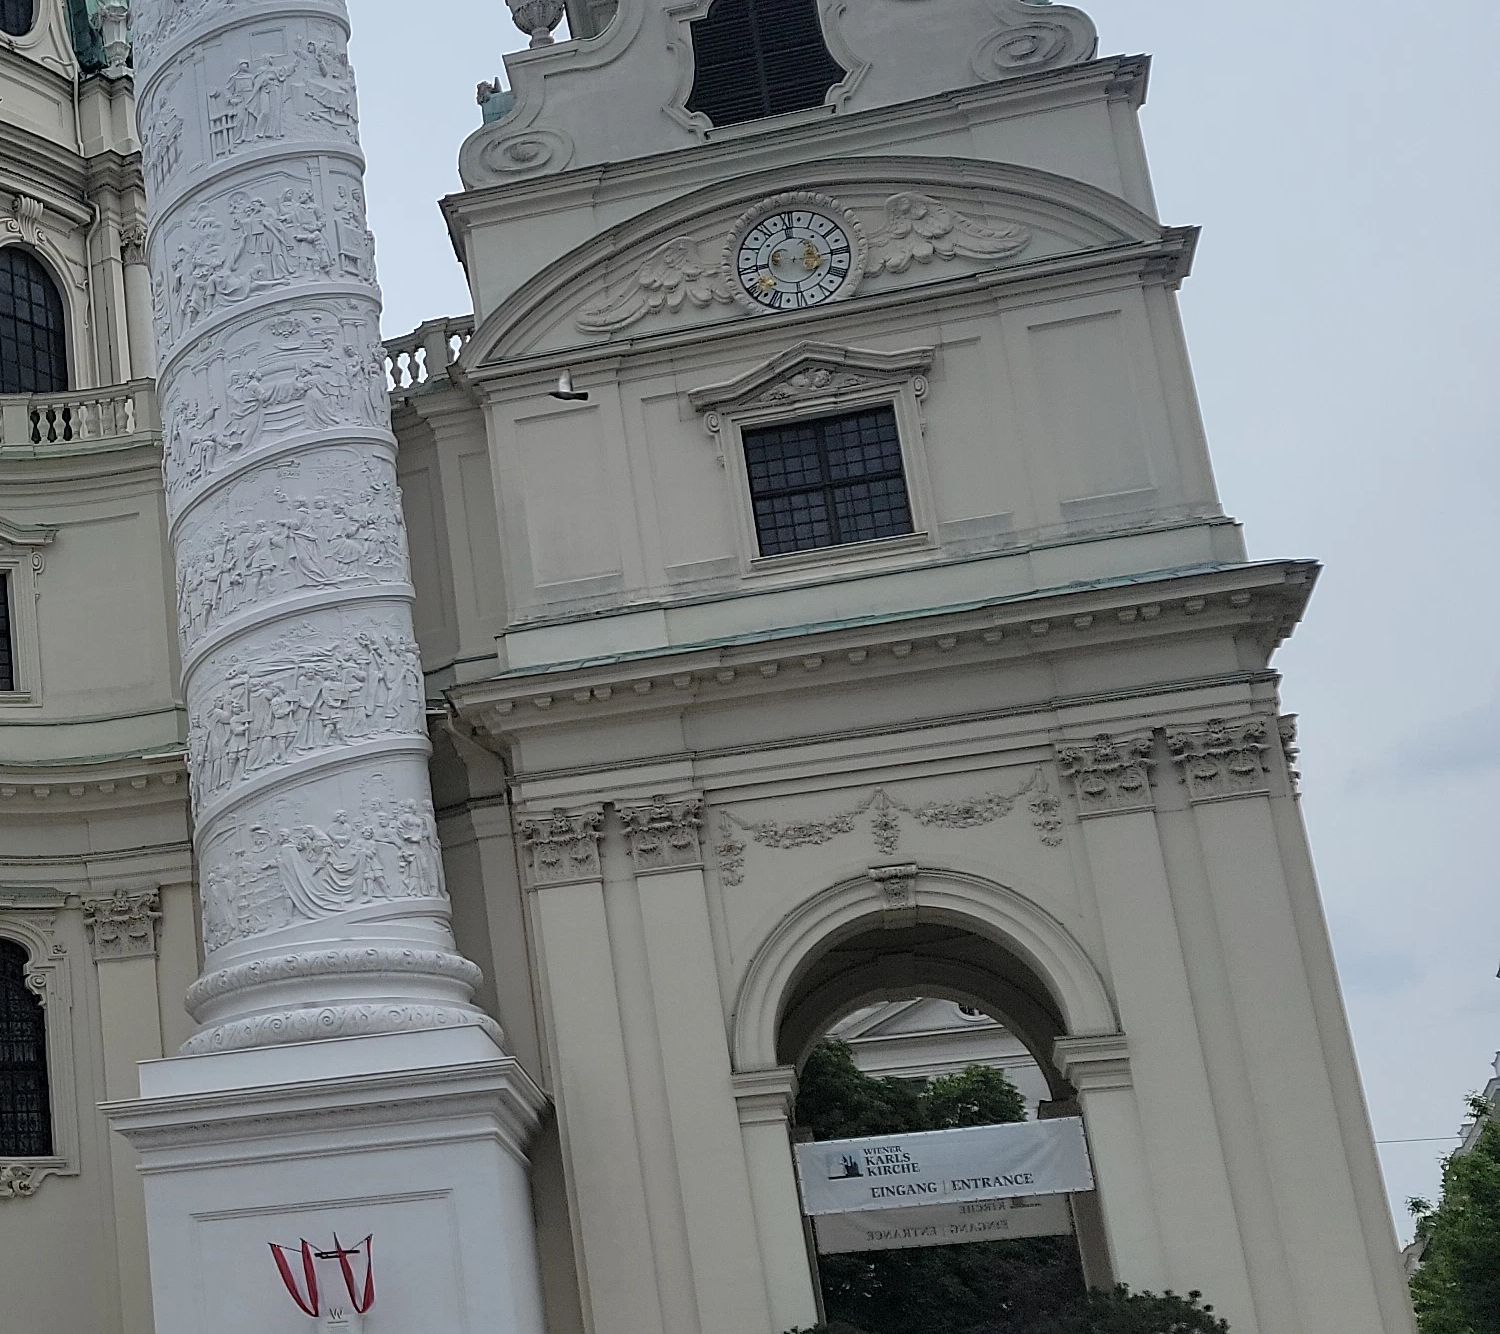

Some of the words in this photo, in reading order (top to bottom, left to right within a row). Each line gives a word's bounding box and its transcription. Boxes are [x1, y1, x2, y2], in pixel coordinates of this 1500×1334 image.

[863, 1145, 902, 1156] WIENER
[865, 1152, 911, 1167] KARLS
[867, 1163, 920, 1177] KIRCHE
[871, 1182, 938, 1199] EINGANG
[951, 1173, 1034, 1191] ENTRANCE
